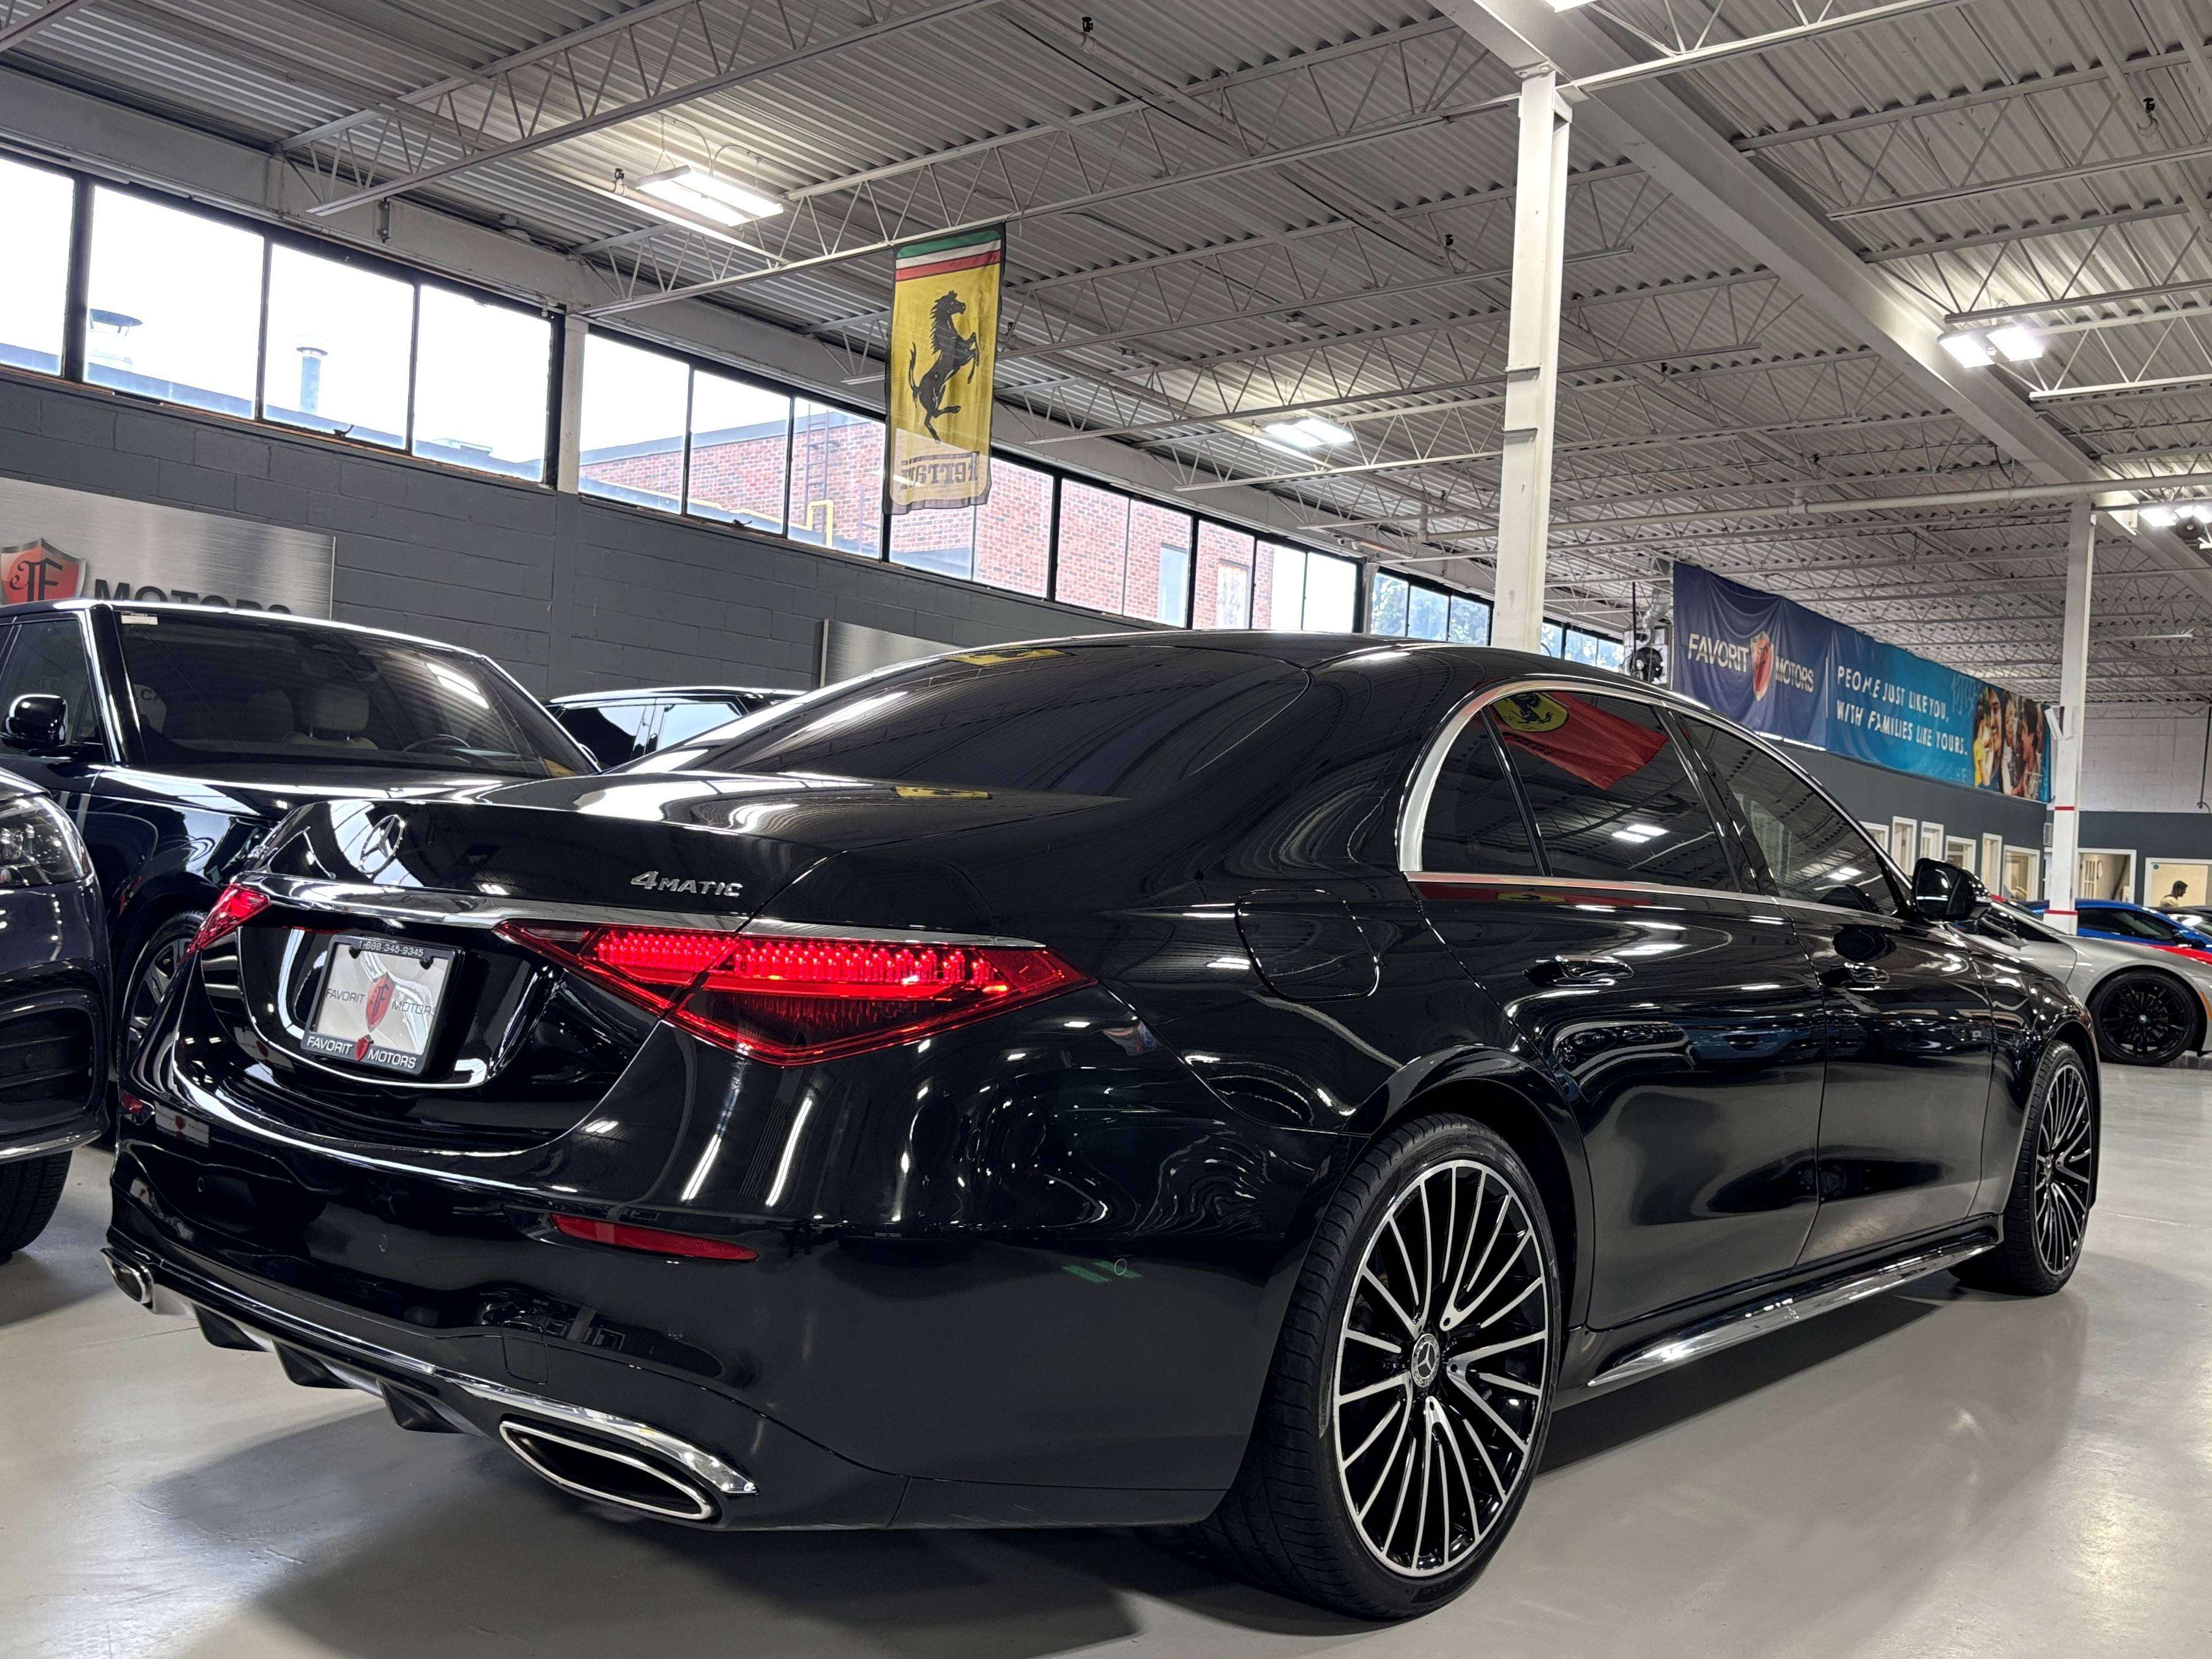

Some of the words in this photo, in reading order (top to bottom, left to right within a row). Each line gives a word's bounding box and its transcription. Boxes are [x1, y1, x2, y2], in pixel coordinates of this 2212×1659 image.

[1688, 633, 1749, 673] FAVORIT
[1775, 656, 1814, 693] MOTORS
[1882, 683, 1906, 706] JUST
[1909, 690, 1928, 714] LIKE
[1929, 698, 1950, 723] YOU,
[1836, 699, 1864, 727] WITH
[1868, 710, 1913, 741] FAMILIES
[1916, 724, 1932, 747] LIKE
[1936, 731, 1968, 755] YOURS.
[630, 870, 744, 898] 4MATIC
[358, 940, 424, 957] 1-888-345-9345
[325, 988, 366, 1004] FAVORIT
[306, 1037, 353, 1055] FAVORIT
[368, 1048, 417, 1069] MOTORS
